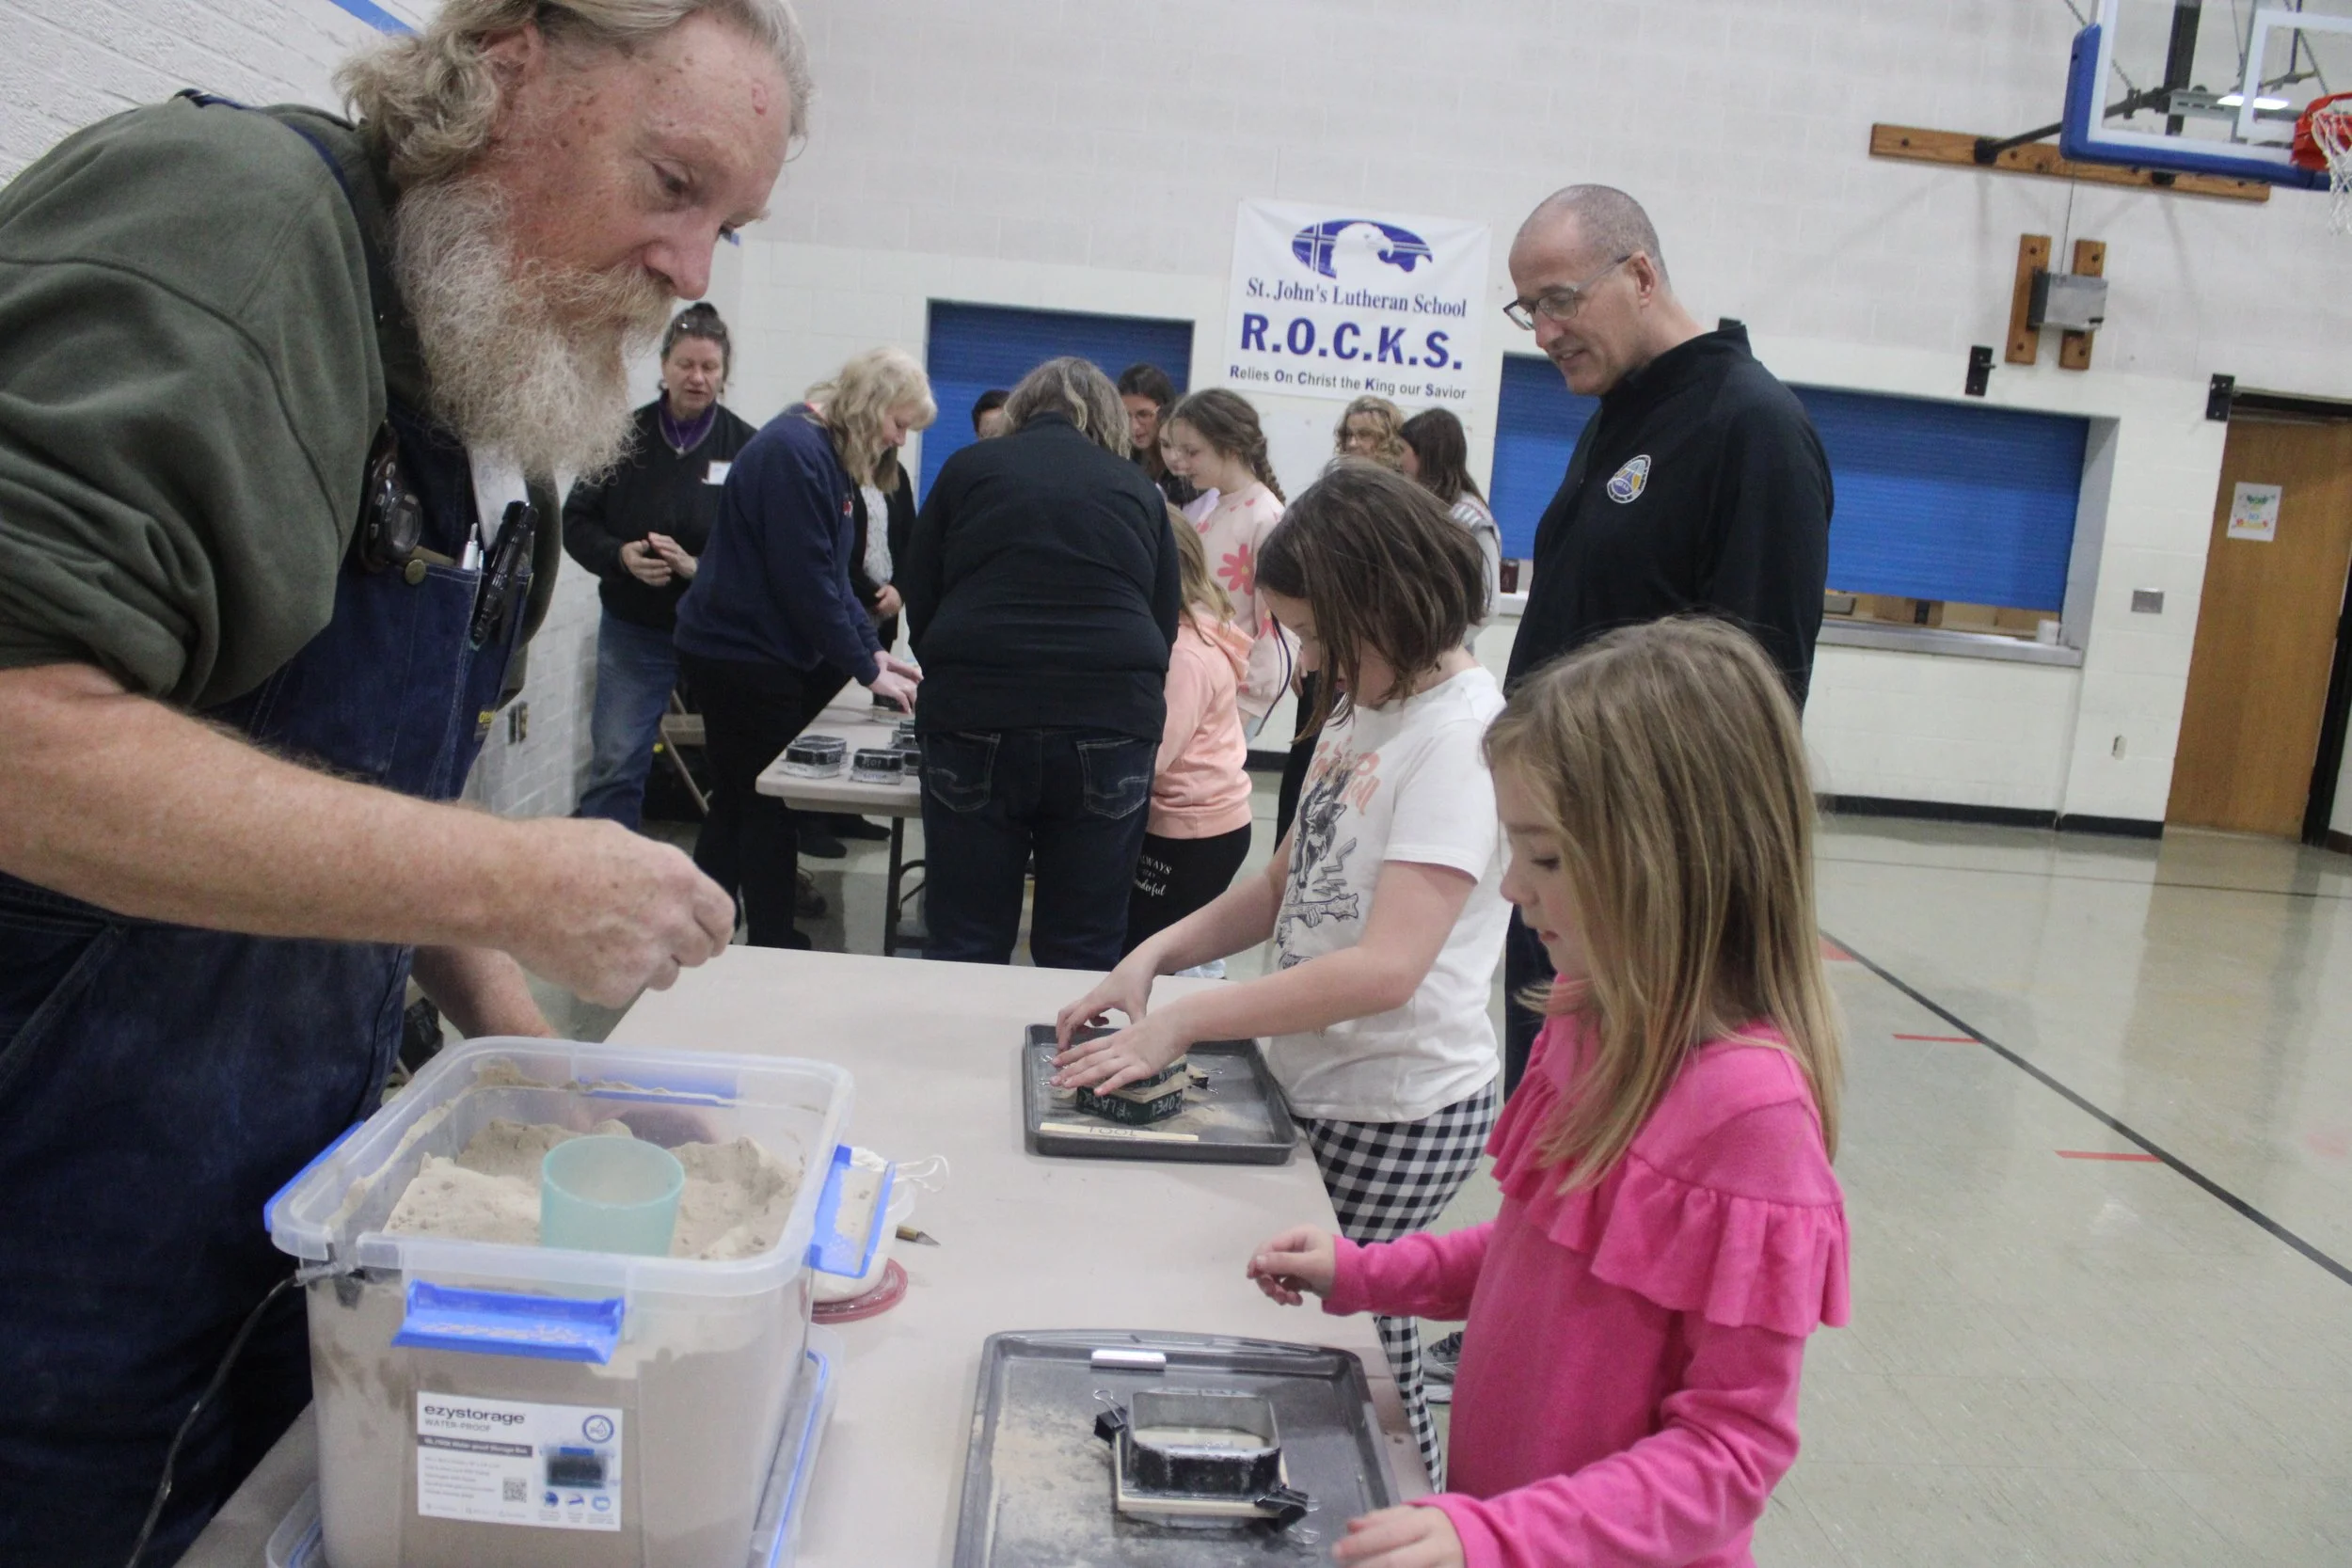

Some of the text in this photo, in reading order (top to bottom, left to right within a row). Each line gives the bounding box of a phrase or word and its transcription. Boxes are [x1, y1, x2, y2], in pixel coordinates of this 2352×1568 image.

[1247, 277, 1467, 318] St. John's Lutheran School
[1241, 312, 1462, 371] R.O.C.K.S.
[1231, 365, 1467, 400] Relies On Christ the King our Savior
[424, 1405, 525, 1426] ezystorage
